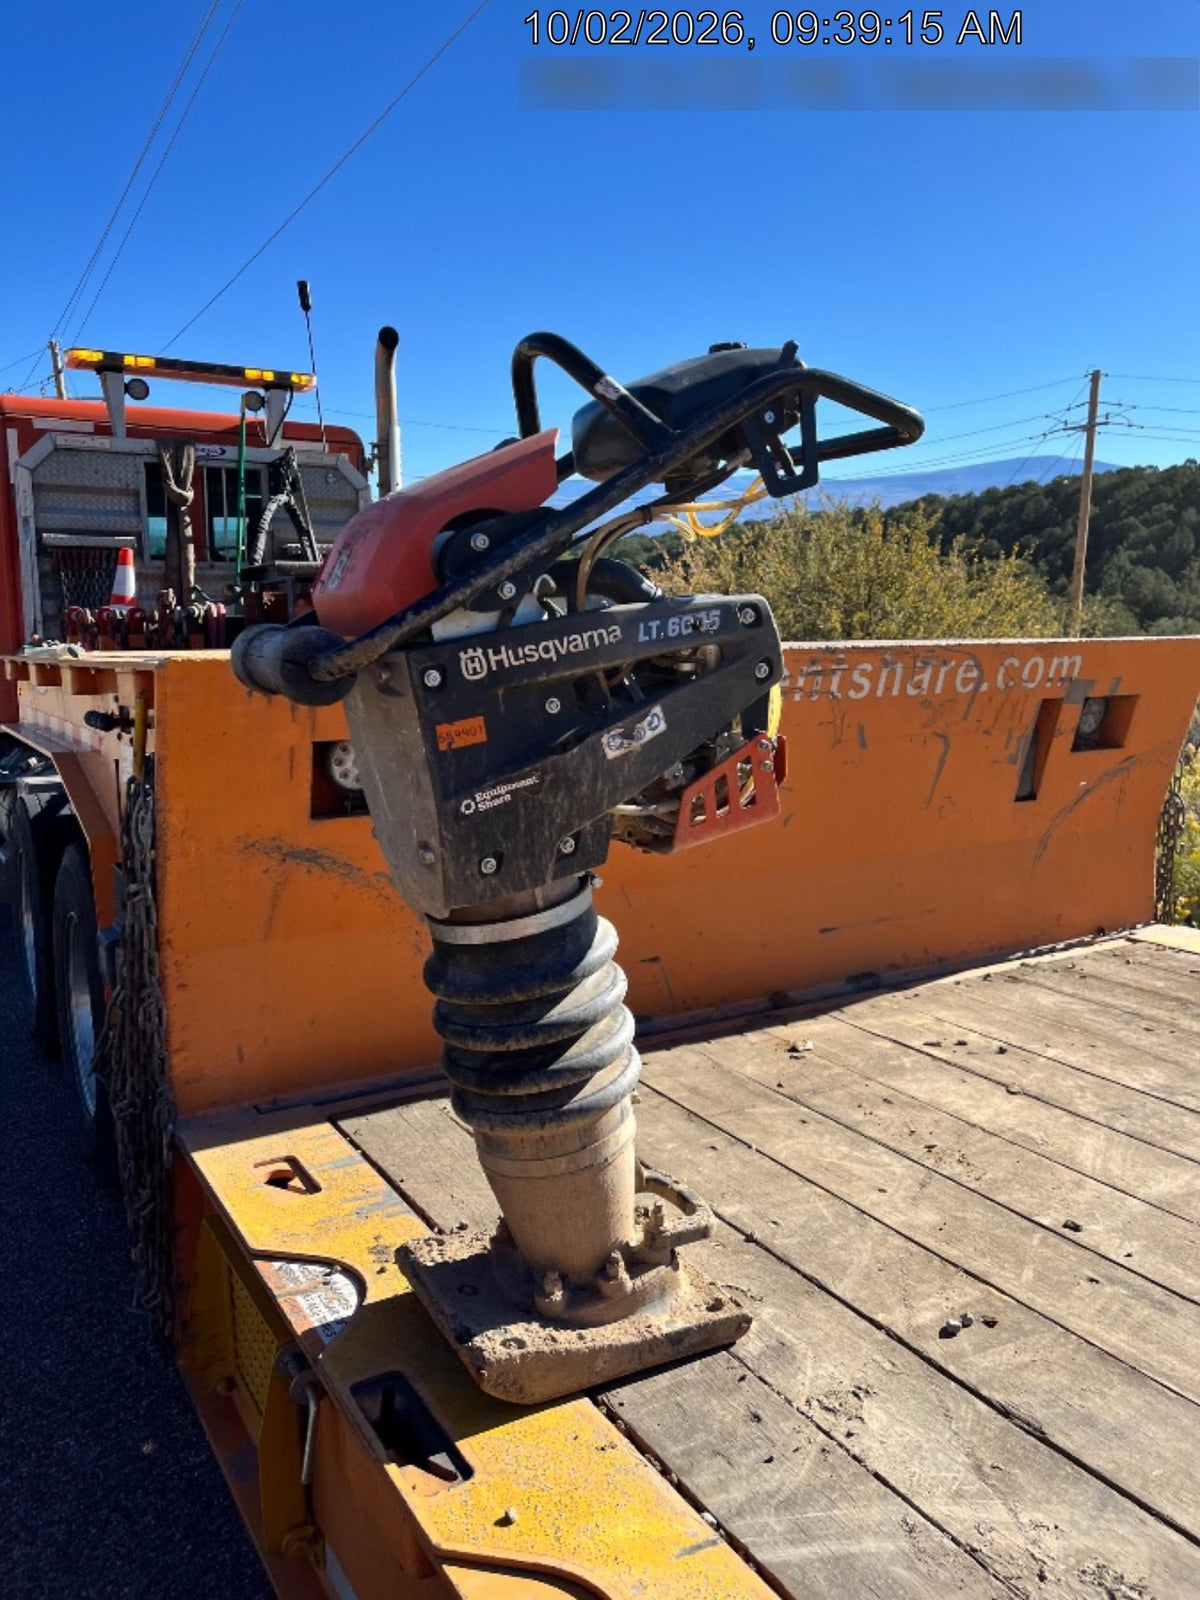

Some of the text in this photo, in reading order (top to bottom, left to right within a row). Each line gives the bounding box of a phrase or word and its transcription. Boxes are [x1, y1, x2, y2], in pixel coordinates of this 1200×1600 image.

[638, 620, 661, 643] LT
[487, 625, 623, 671] Husqvarna
[477, 793, 512, 811] Share
